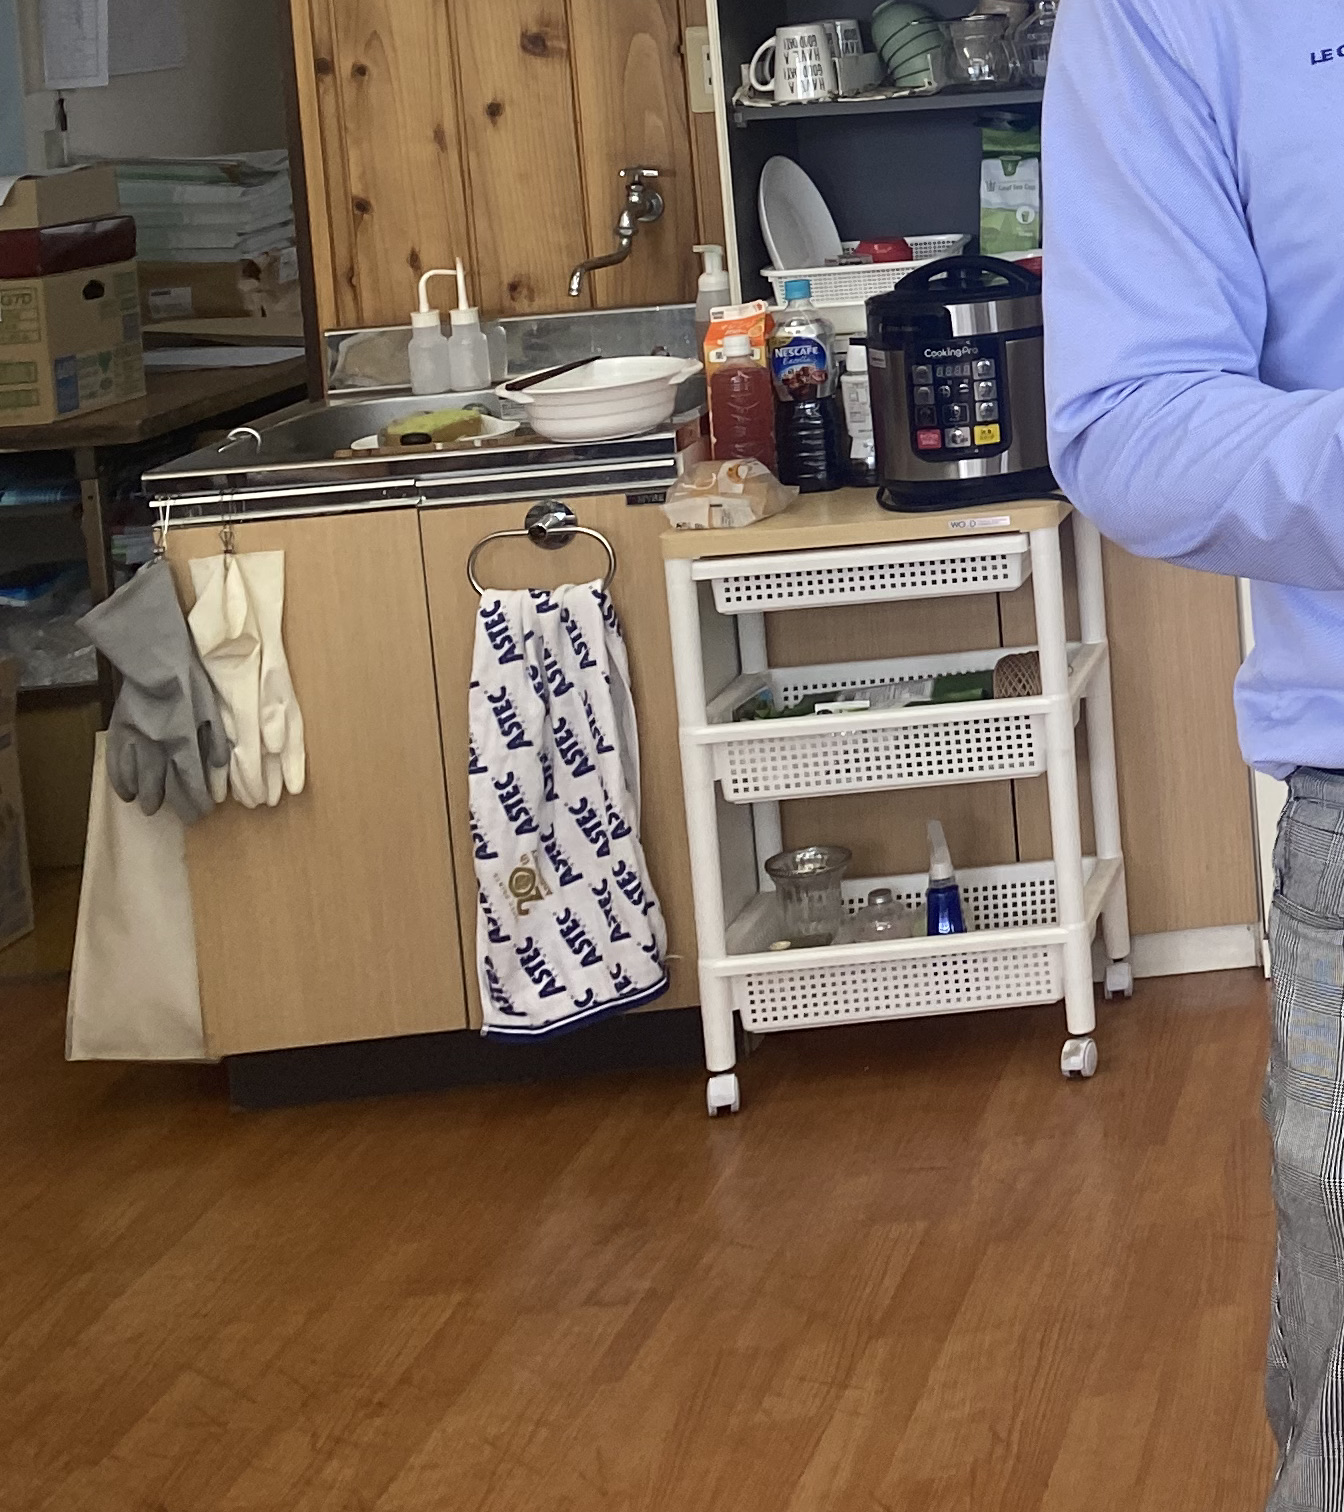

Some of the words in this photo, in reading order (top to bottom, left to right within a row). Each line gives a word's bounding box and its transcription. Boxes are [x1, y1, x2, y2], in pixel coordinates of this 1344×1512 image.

[1310, 47, 1333, 65] LE
[480, 600, 524, 665] ASTEC
[560, 607, 597, 669] ASTEC
[487, 686, 533, 750] ASTEC
[553, 717, 596, 778] ASTEC
[494, 771, 540, 836] ASTEC
[568, 797, 611, 858] ASTEC
[515, 936, 567, 999] ASTEC
[556, 907, 603, 968] ASTEC
